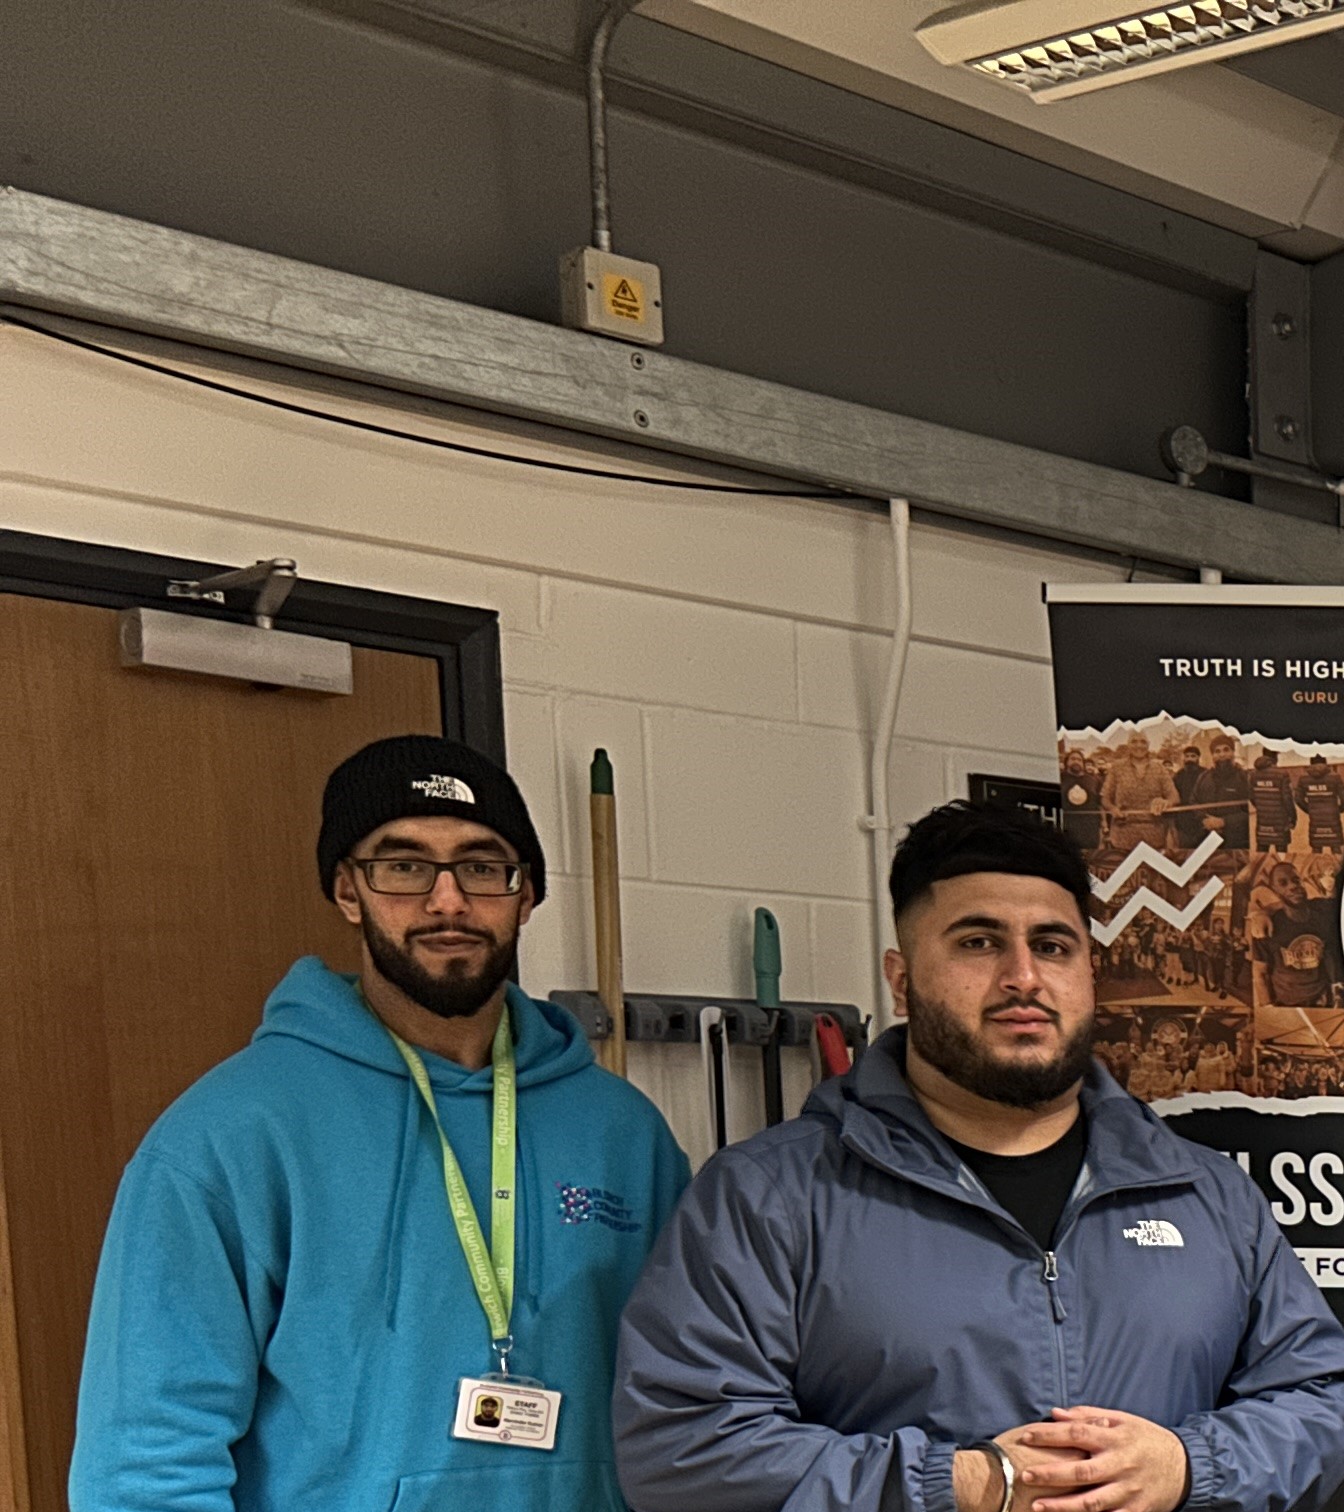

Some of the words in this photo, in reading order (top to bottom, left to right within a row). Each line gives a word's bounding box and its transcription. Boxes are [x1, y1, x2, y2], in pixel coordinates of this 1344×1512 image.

[1160, 658, 1242, 677] TRUTH
[1253, 659, 1275, 677] IS
[1292, 691, 1338, 704] GURU
[496, 1076, 512, 1146] Partnership
[462, 1218, 492, 1293] Community
